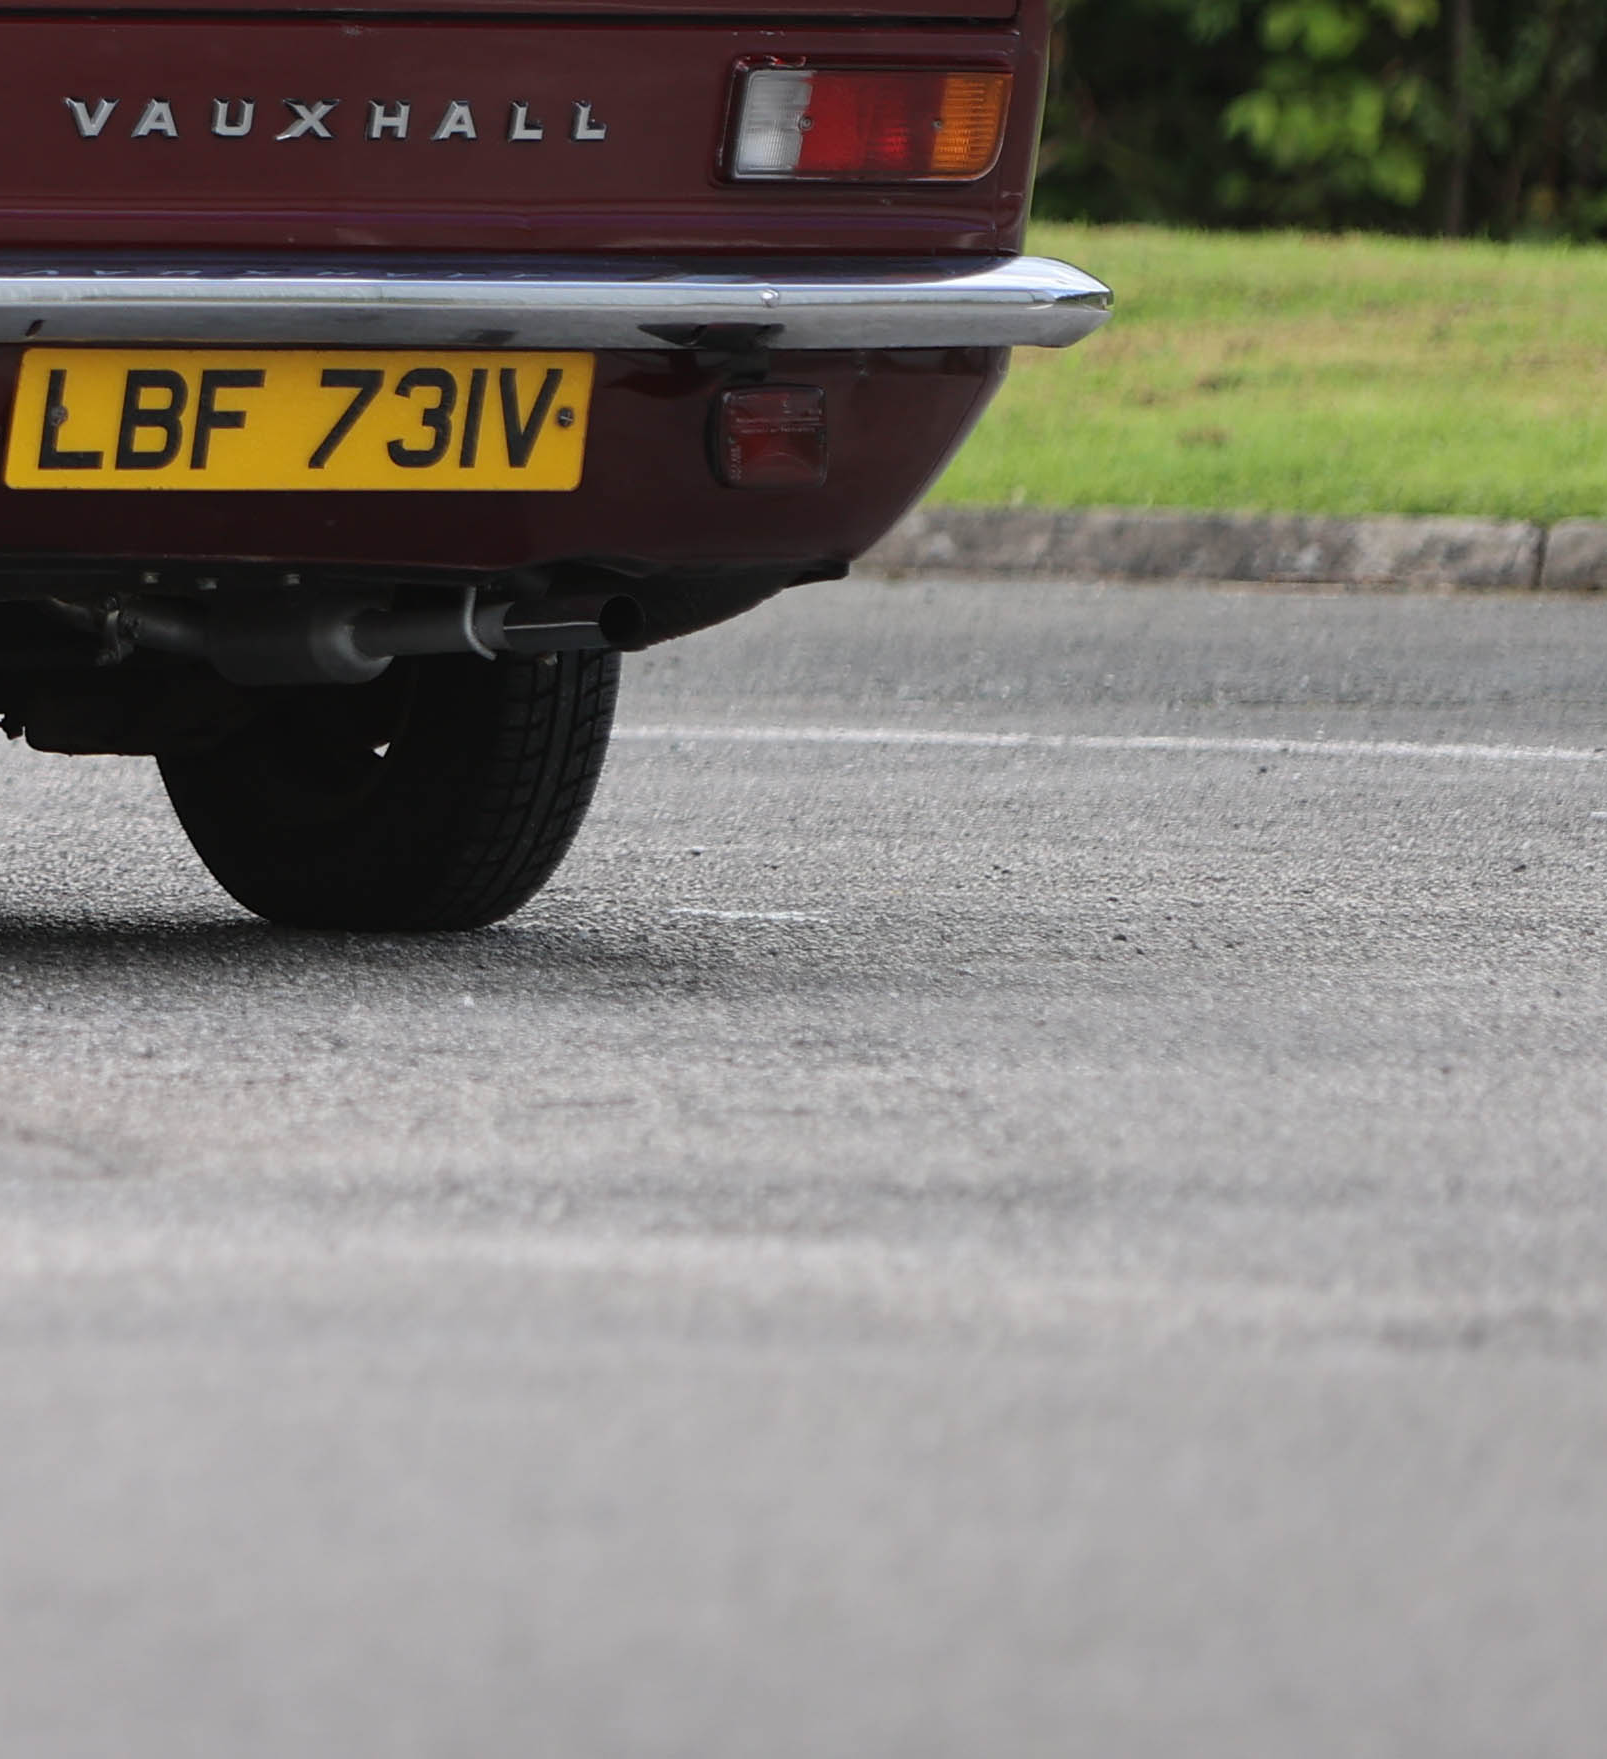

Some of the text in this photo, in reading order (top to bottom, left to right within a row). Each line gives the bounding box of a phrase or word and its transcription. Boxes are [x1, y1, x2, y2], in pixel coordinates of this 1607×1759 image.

[63, 97, 608, 141] VAUXHALL
[38, 367, 563, 471] LBF 731V
